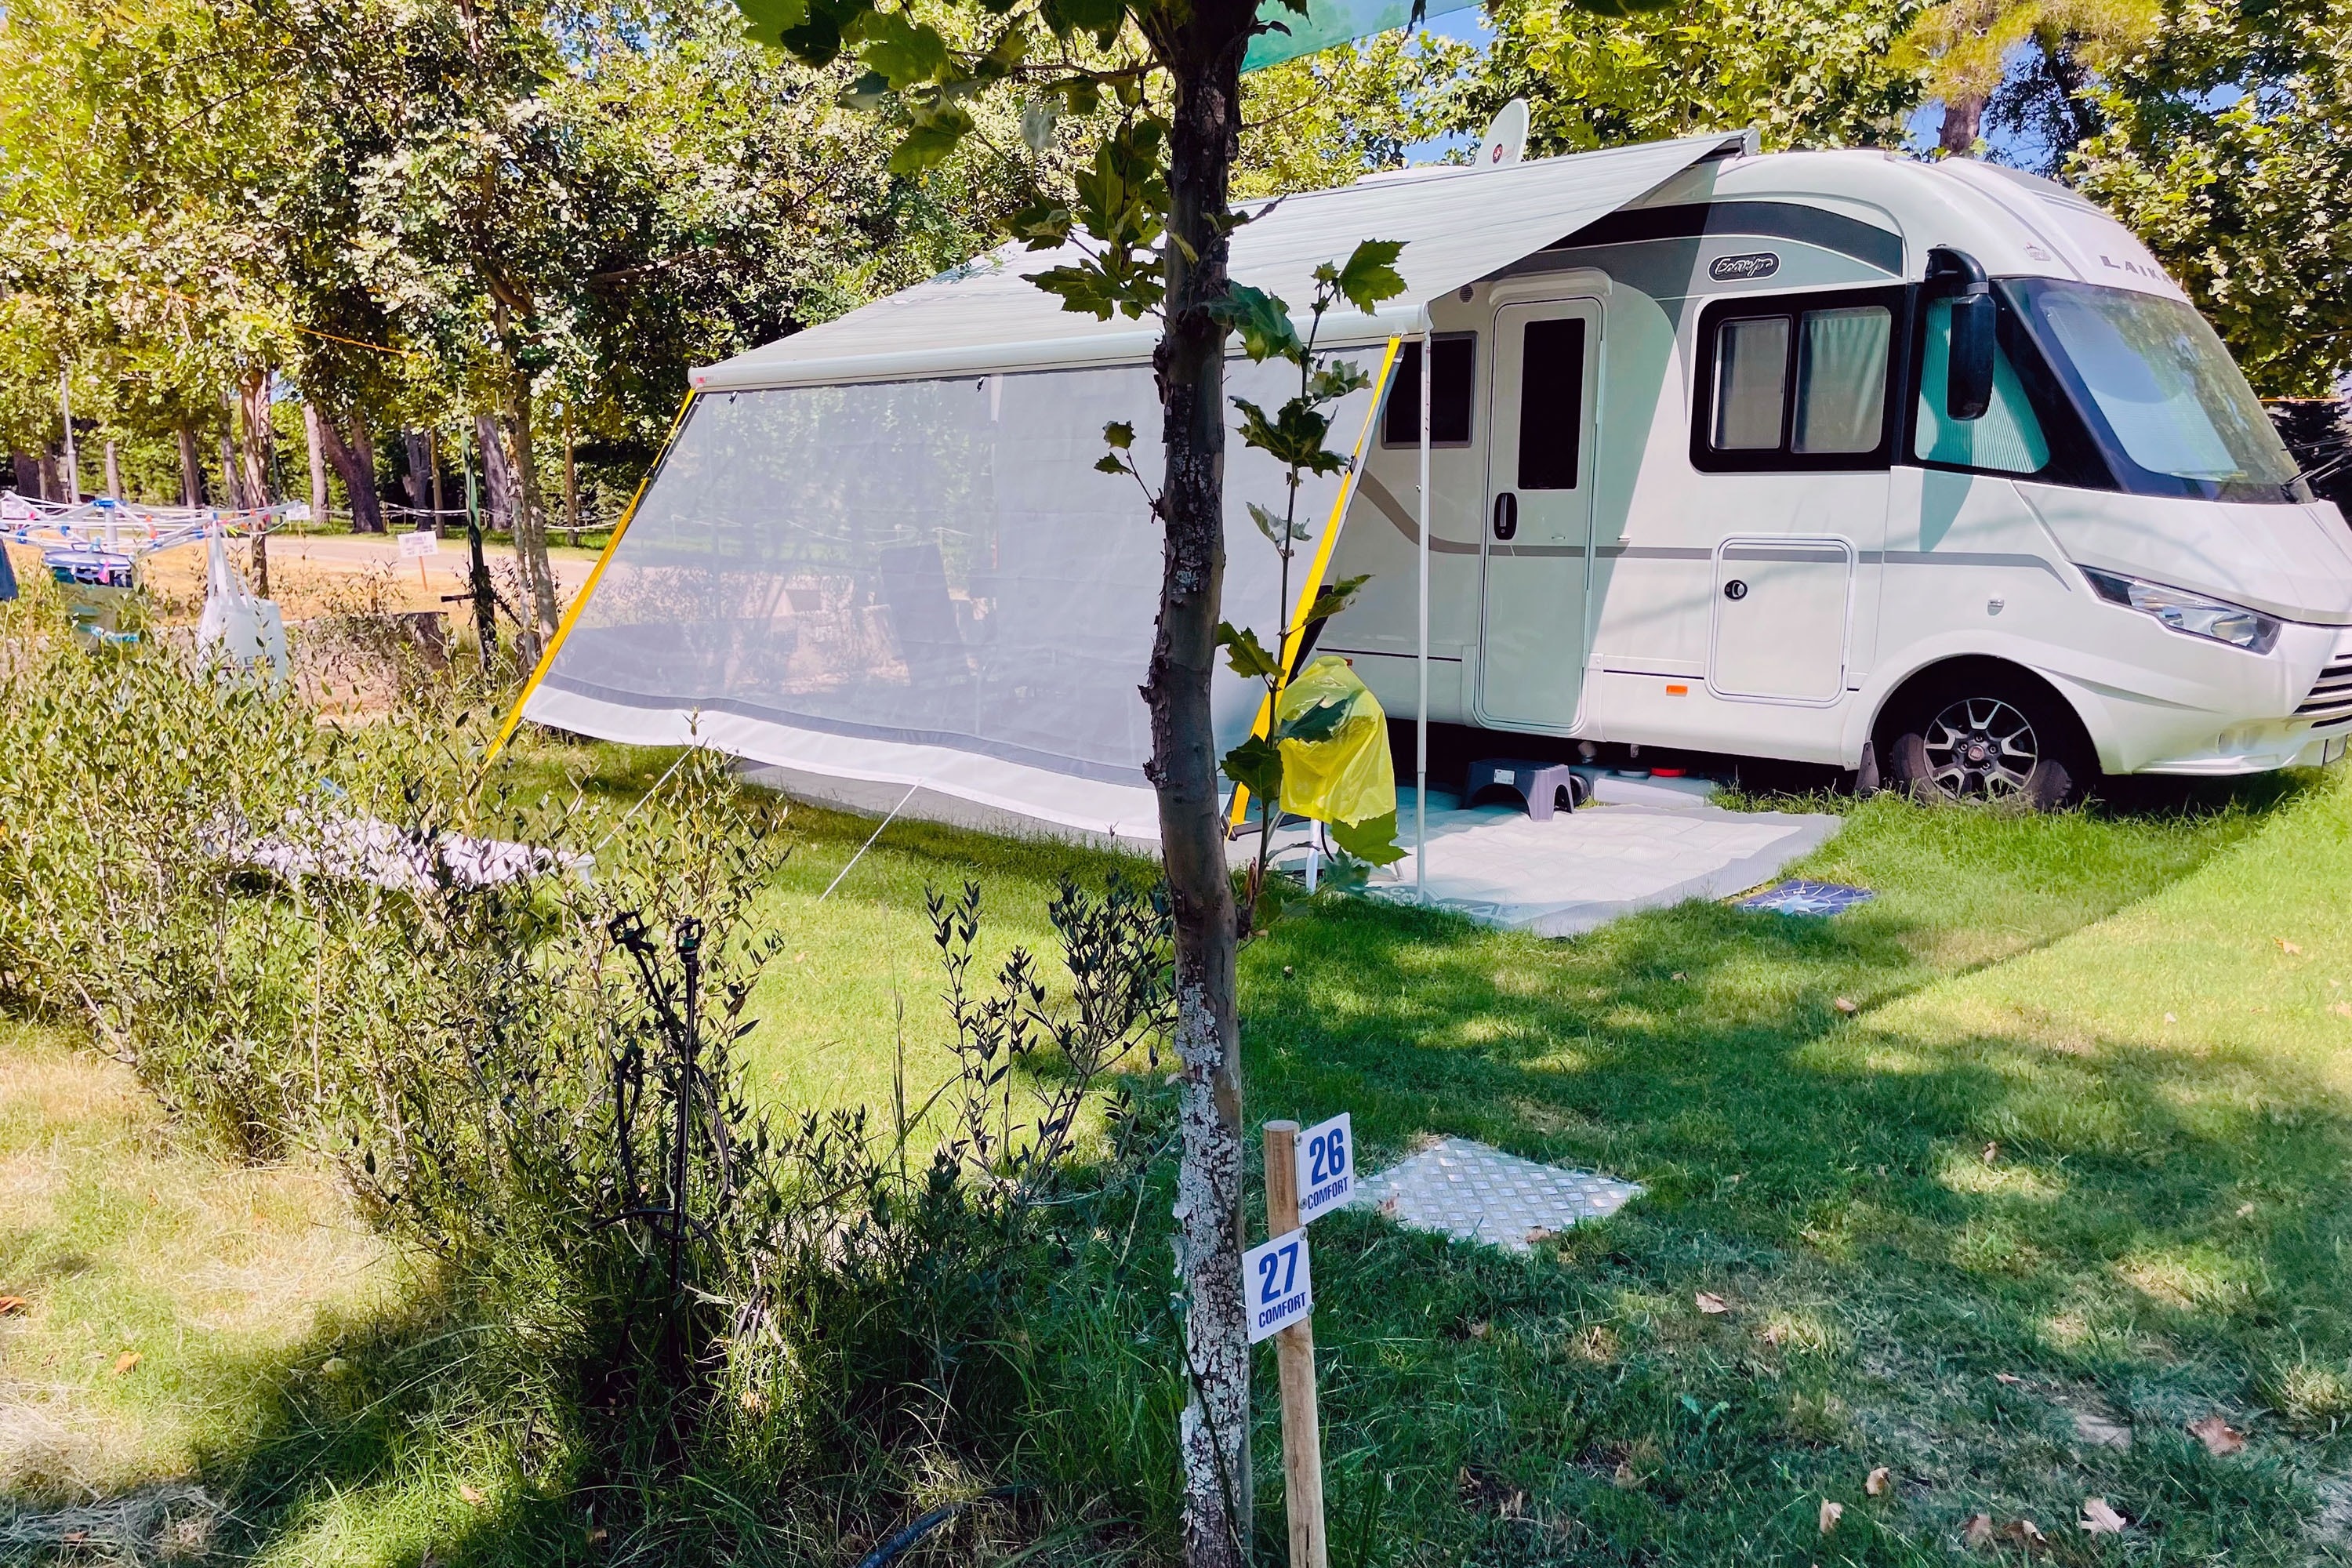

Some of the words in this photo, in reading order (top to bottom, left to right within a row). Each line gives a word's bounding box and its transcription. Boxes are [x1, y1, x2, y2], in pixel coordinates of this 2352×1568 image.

[2099, 255, 2172, 285] LAIKA
[1309, 1128, 1345, 1186] 26
[1307, 1176, 1348, 1210] COMFORT
[1258, 1241, 1298, 1305] 27
[1258, 1291, 1306, 1328] COMFORT
